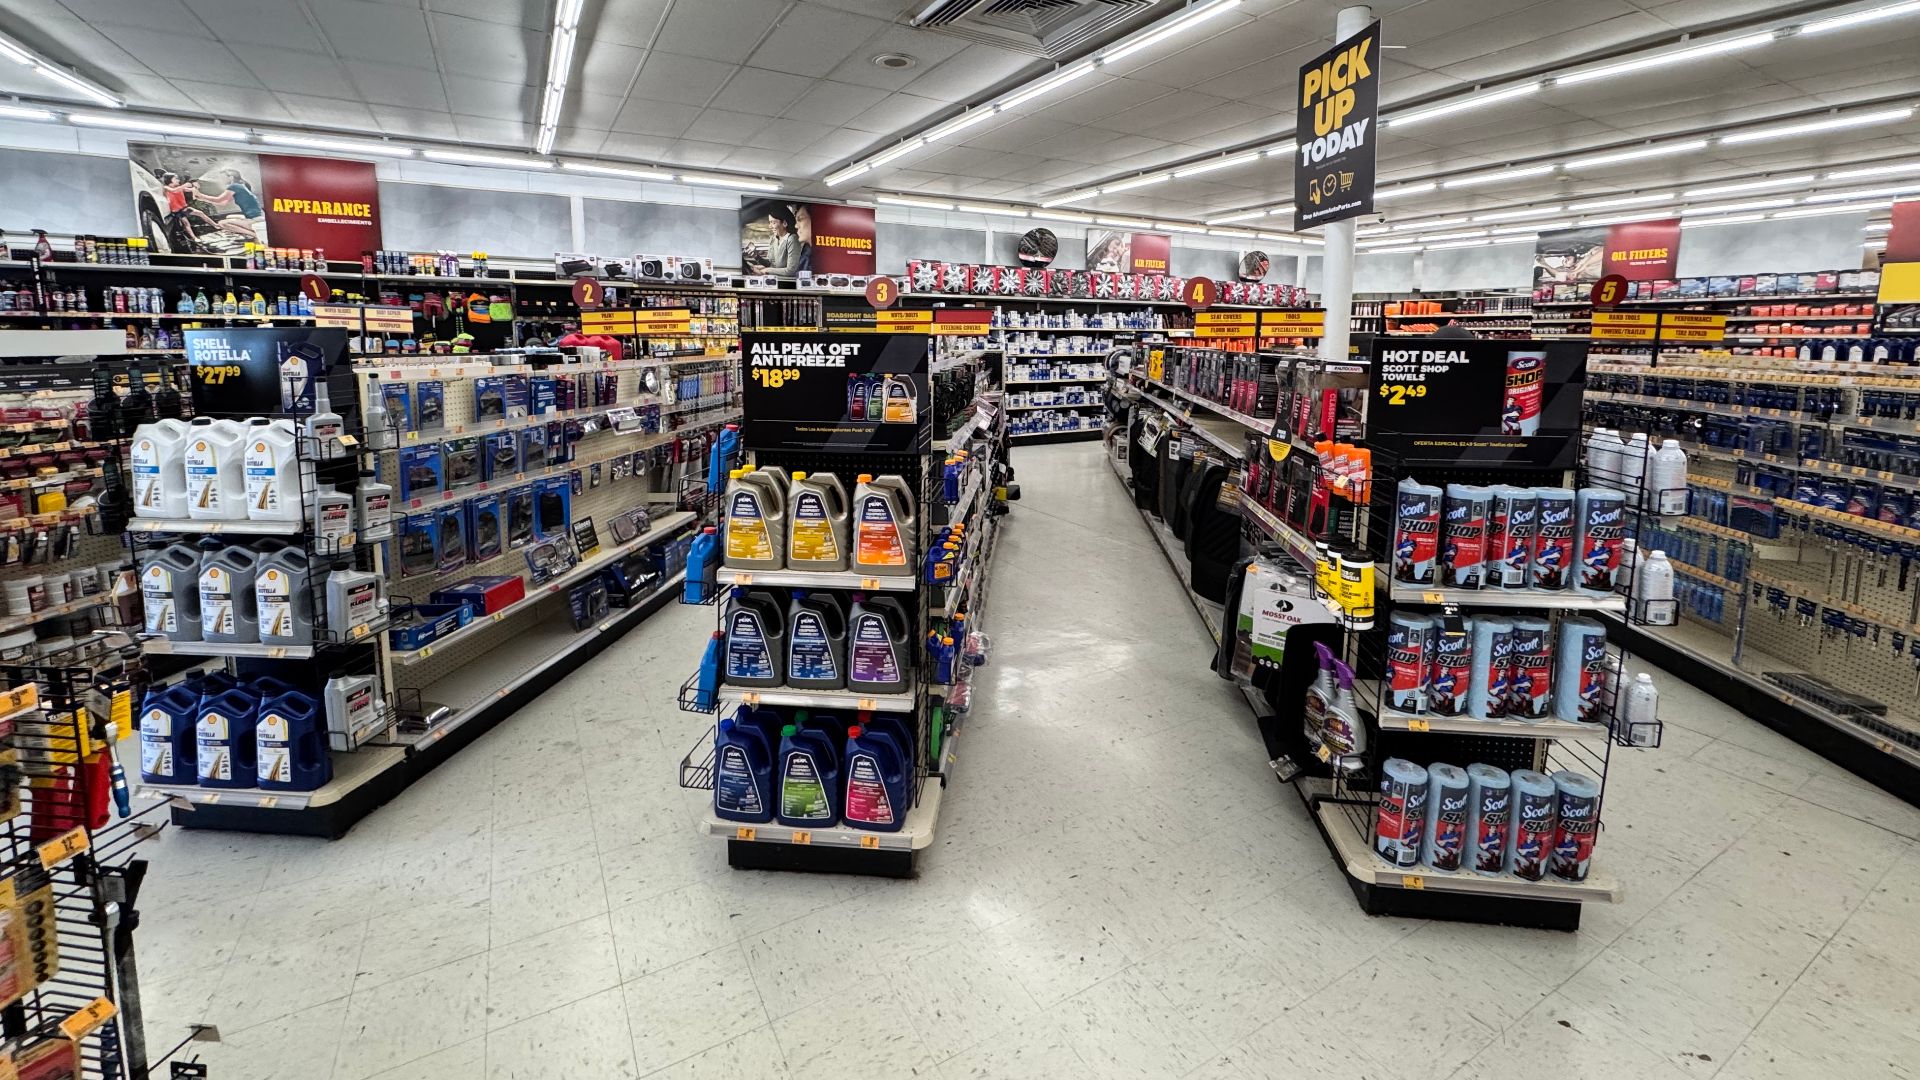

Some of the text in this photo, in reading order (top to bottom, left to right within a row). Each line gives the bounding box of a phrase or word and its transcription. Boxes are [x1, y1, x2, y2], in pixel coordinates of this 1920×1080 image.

[1303, 37, 1372, 109] PICK
[1314, 88, 1355, 137] UP
[1302, 117, 1369, 167] TODAY
[272, 198, 371, 217] APPEARANCE
[816, 235, 872, 250] ELECTRONICS
[1611, 247, 1668, 262] OIL FILTERS
[1135, 258, 1166, 269] AIR FILTERS
[310, 279, 321, 298] 1
[582, 283, 594, 303] 2
[876, 283, 888, 302] 3
[1192, 283, 1205, 303] 4
[1600, 281, 1617, 303] 5
[193, 338, 230, 350] SHELL
[750, 342, 779, 355] ALL
[828, 343, 861, 356] OET
[194, 349, 251, 361] ROTELLA
[750, 355, 845, 367] ANTIFREEZE
[1382, 350, 1470, 364] HOT DEAL
[1420, 365, 1449, 373] SHOP
[1516, 360, 1537, 369] Scott
[1382, 372, 1426, 381] TOWELS
[1505, 368, 1543, 387] SHOP
[1507, 383, 1539, 395] ORIGINAL
[1327, 393, 1337, 423] CLASSIC
[1400, 501, 1426, 517] Scott
[1540, 505, 1570, 524] Scott
[1588, 507, 1621, 526] Scott
[1401, 518, 1437, 533] SHOP
[1510, 525, 1534, 538] SH
[1262, 609, 1302, 624] MOSSY OAK
[1388, 631, 1404, 643] cott
[1437, 636, 1464, 653] Scott
[1511, 637, 1540, 651] Scott
[1585, 645, 1604, 661] Sco
[1494, 656, 1511, 669] SH
[1586, 660, 1604, 673] SH
[1380, 798, 1400, 814] OP
[1522, 803, 1550, 819] Scott
[1560, 803, 1590, 818] Scott
